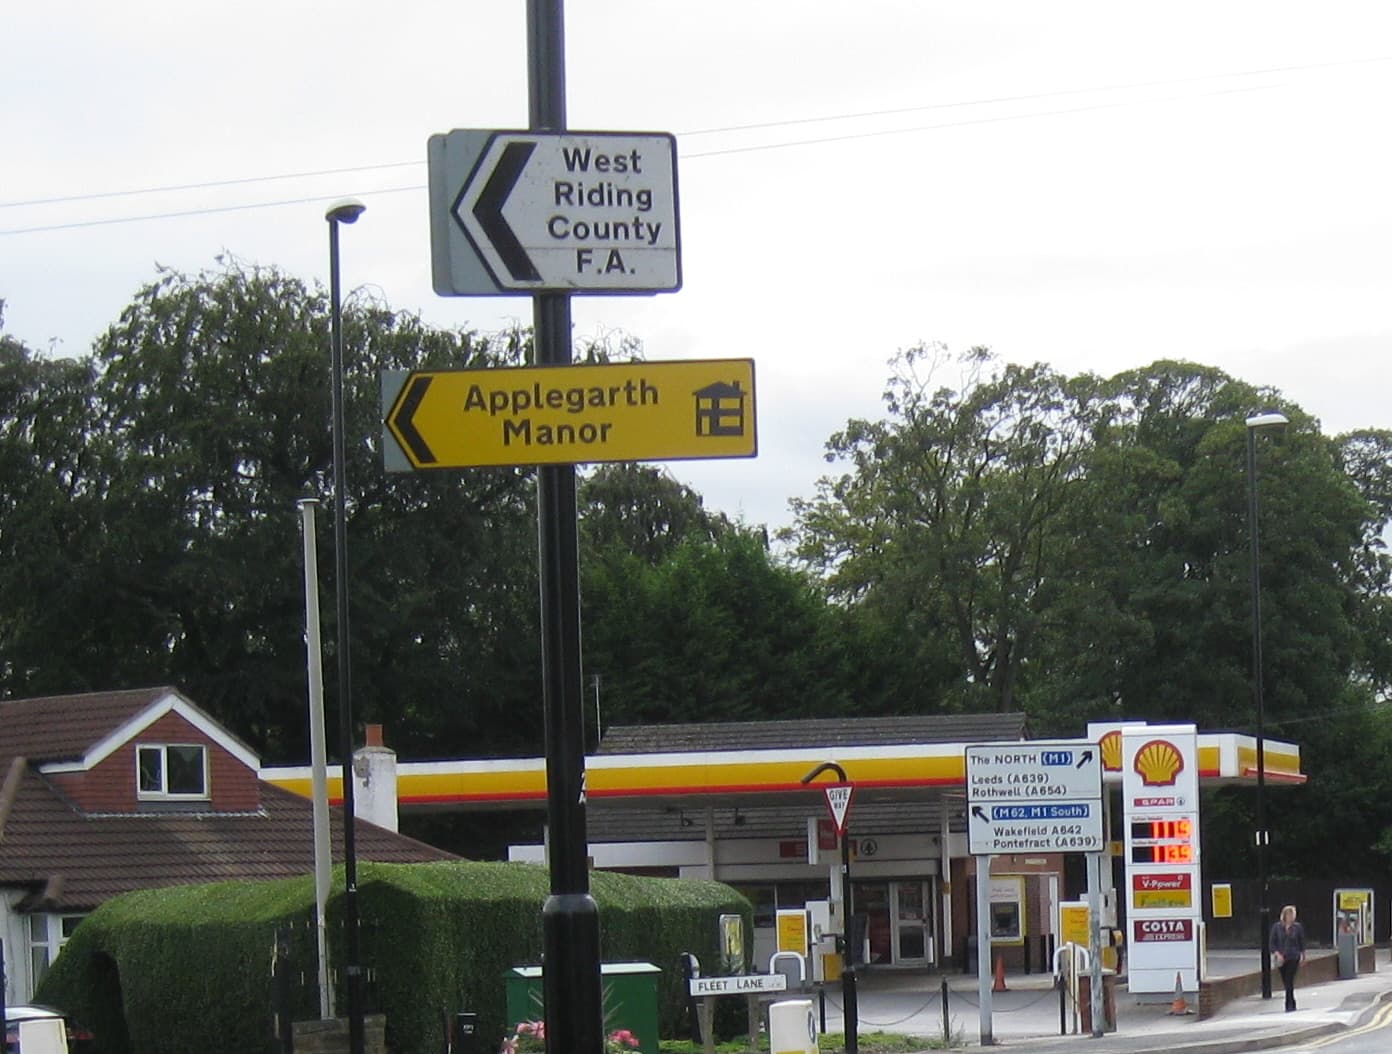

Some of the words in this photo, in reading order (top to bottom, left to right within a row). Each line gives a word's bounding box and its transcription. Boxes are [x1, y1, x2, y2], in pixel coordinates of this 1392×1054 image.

[562, 147, 642, 174] West
[554, 181, 653, 211] Riding
[547, 215, 662, 244] County
[576, 249, 636, 274] F.A.
[463, 379, 659, 416] Applegarth
[503, 418, 613, 446] Manor
[970, 755, 990, 765] The
[995, 754, 1037, 764] NORTH
[1042, 751, 1071, 765] (M1)
[972, 774, 1003, 785] Leeds
[1007, 772, 1049, 785] (A639)
[829, 788, 848, 800] GIVE
[972, 786, 1021, 797] Rothwell
[1025, 785, 1067, 797] (A654)
[1142, 798, 1174, 806] SPAR
[1031, 807, 1047, 817] M1
[1051, 806, 1088, 818] South)
[993, 825, 1048, 837] Wakefield
[1051, 825, 1082, 836] A642
[993, 838, 1051, 849] Pontefract
[1055, 836, 1097, 849] (A639)
[1142, 921, 1185, 932] COSTA
[698, 980, 728, 991] FLEET
[736, 978, 764, 989] LANE
